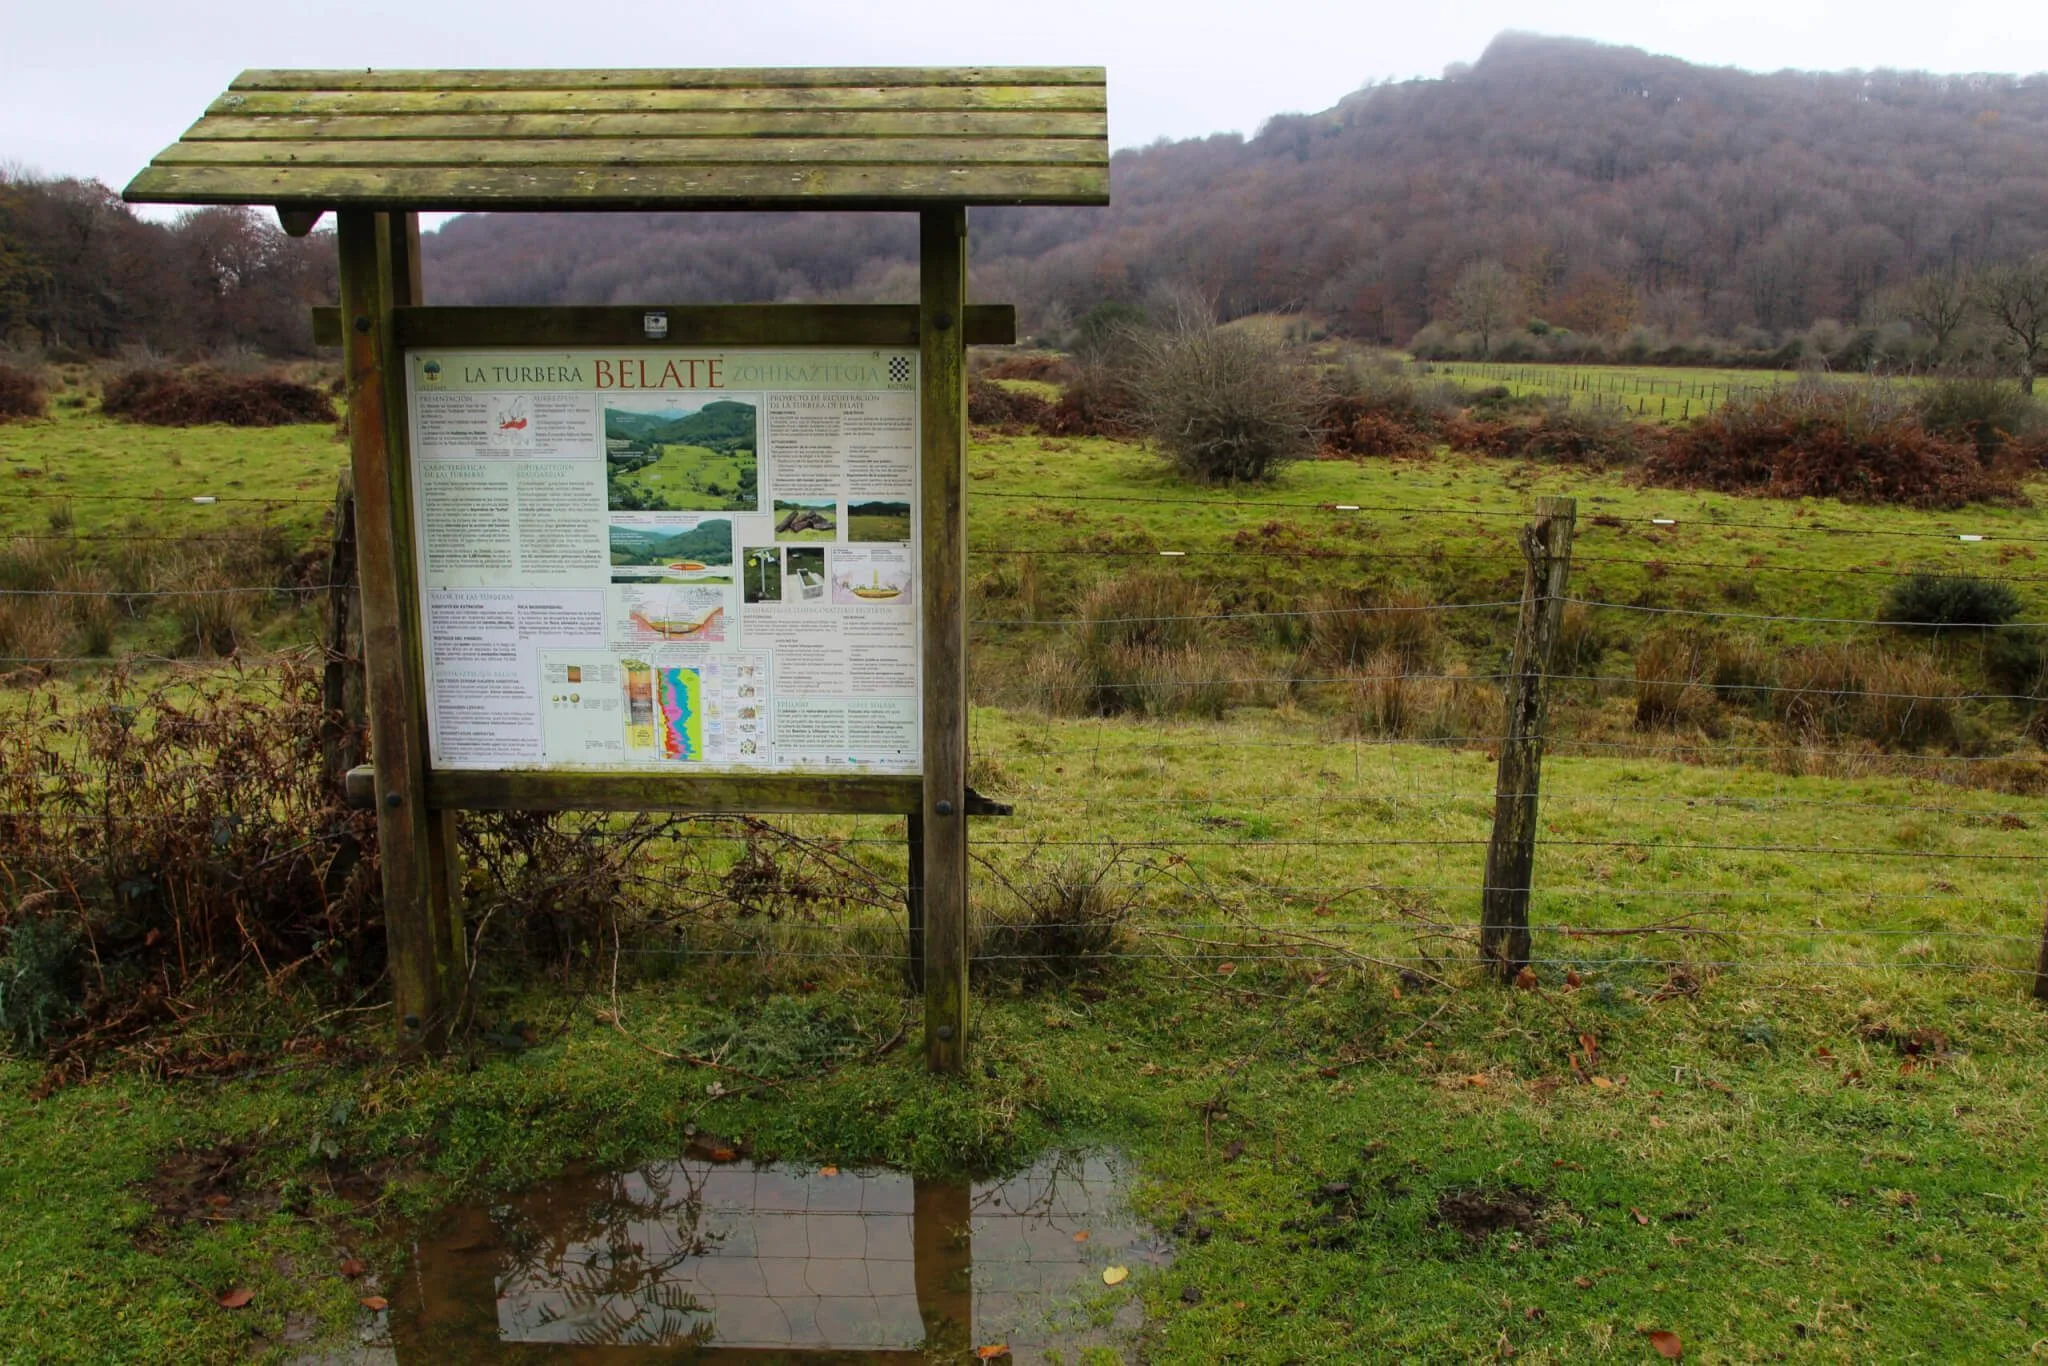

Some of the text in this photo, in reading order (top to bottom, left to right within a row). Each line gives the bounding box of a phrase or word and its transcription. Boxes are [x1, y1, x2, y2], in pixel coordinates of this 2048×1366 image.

[464, 366, 487, 383] LA
[492, 366, 583, 383] TURBERA
[593, 359, 724, 388] BELATE
